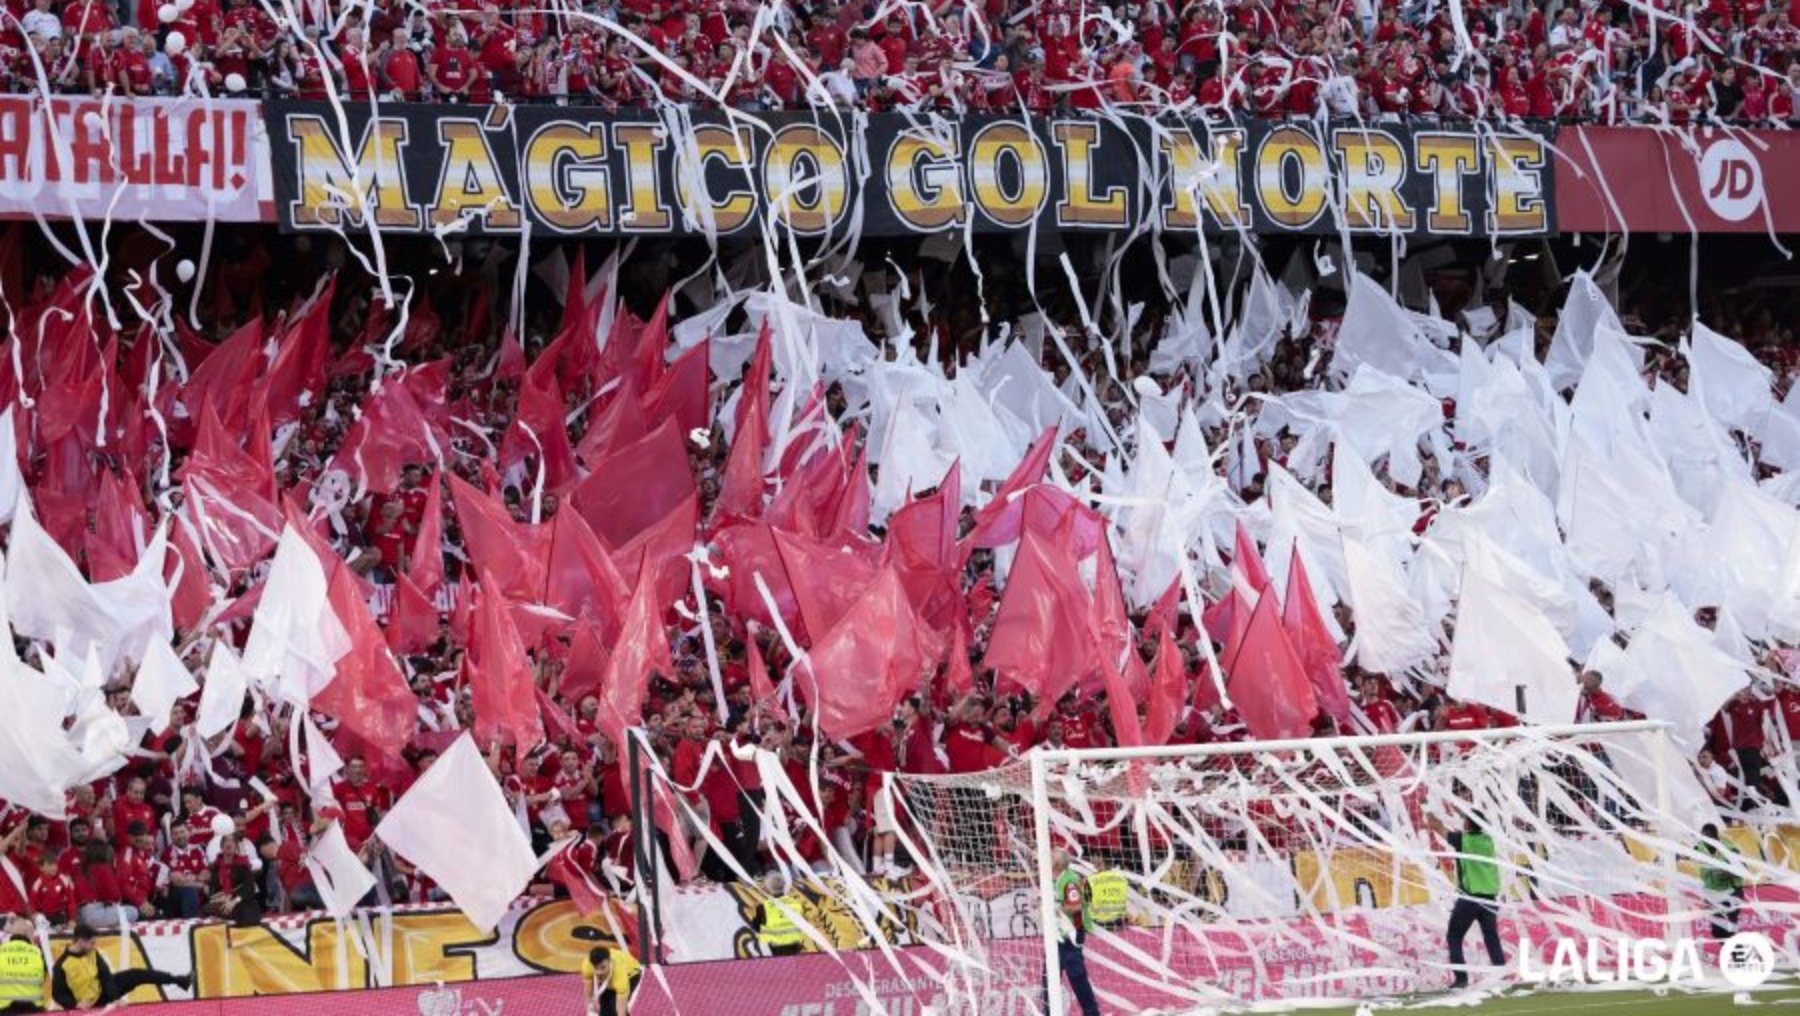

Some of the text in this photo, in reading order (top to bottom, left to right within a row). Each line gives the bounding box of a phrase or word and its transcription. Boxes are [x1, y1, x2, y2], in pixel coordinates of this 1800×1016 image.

[286, 104, 1548, 234] MÁGICO GOL NORTE
[1710, 159, 1754, 199] JD
